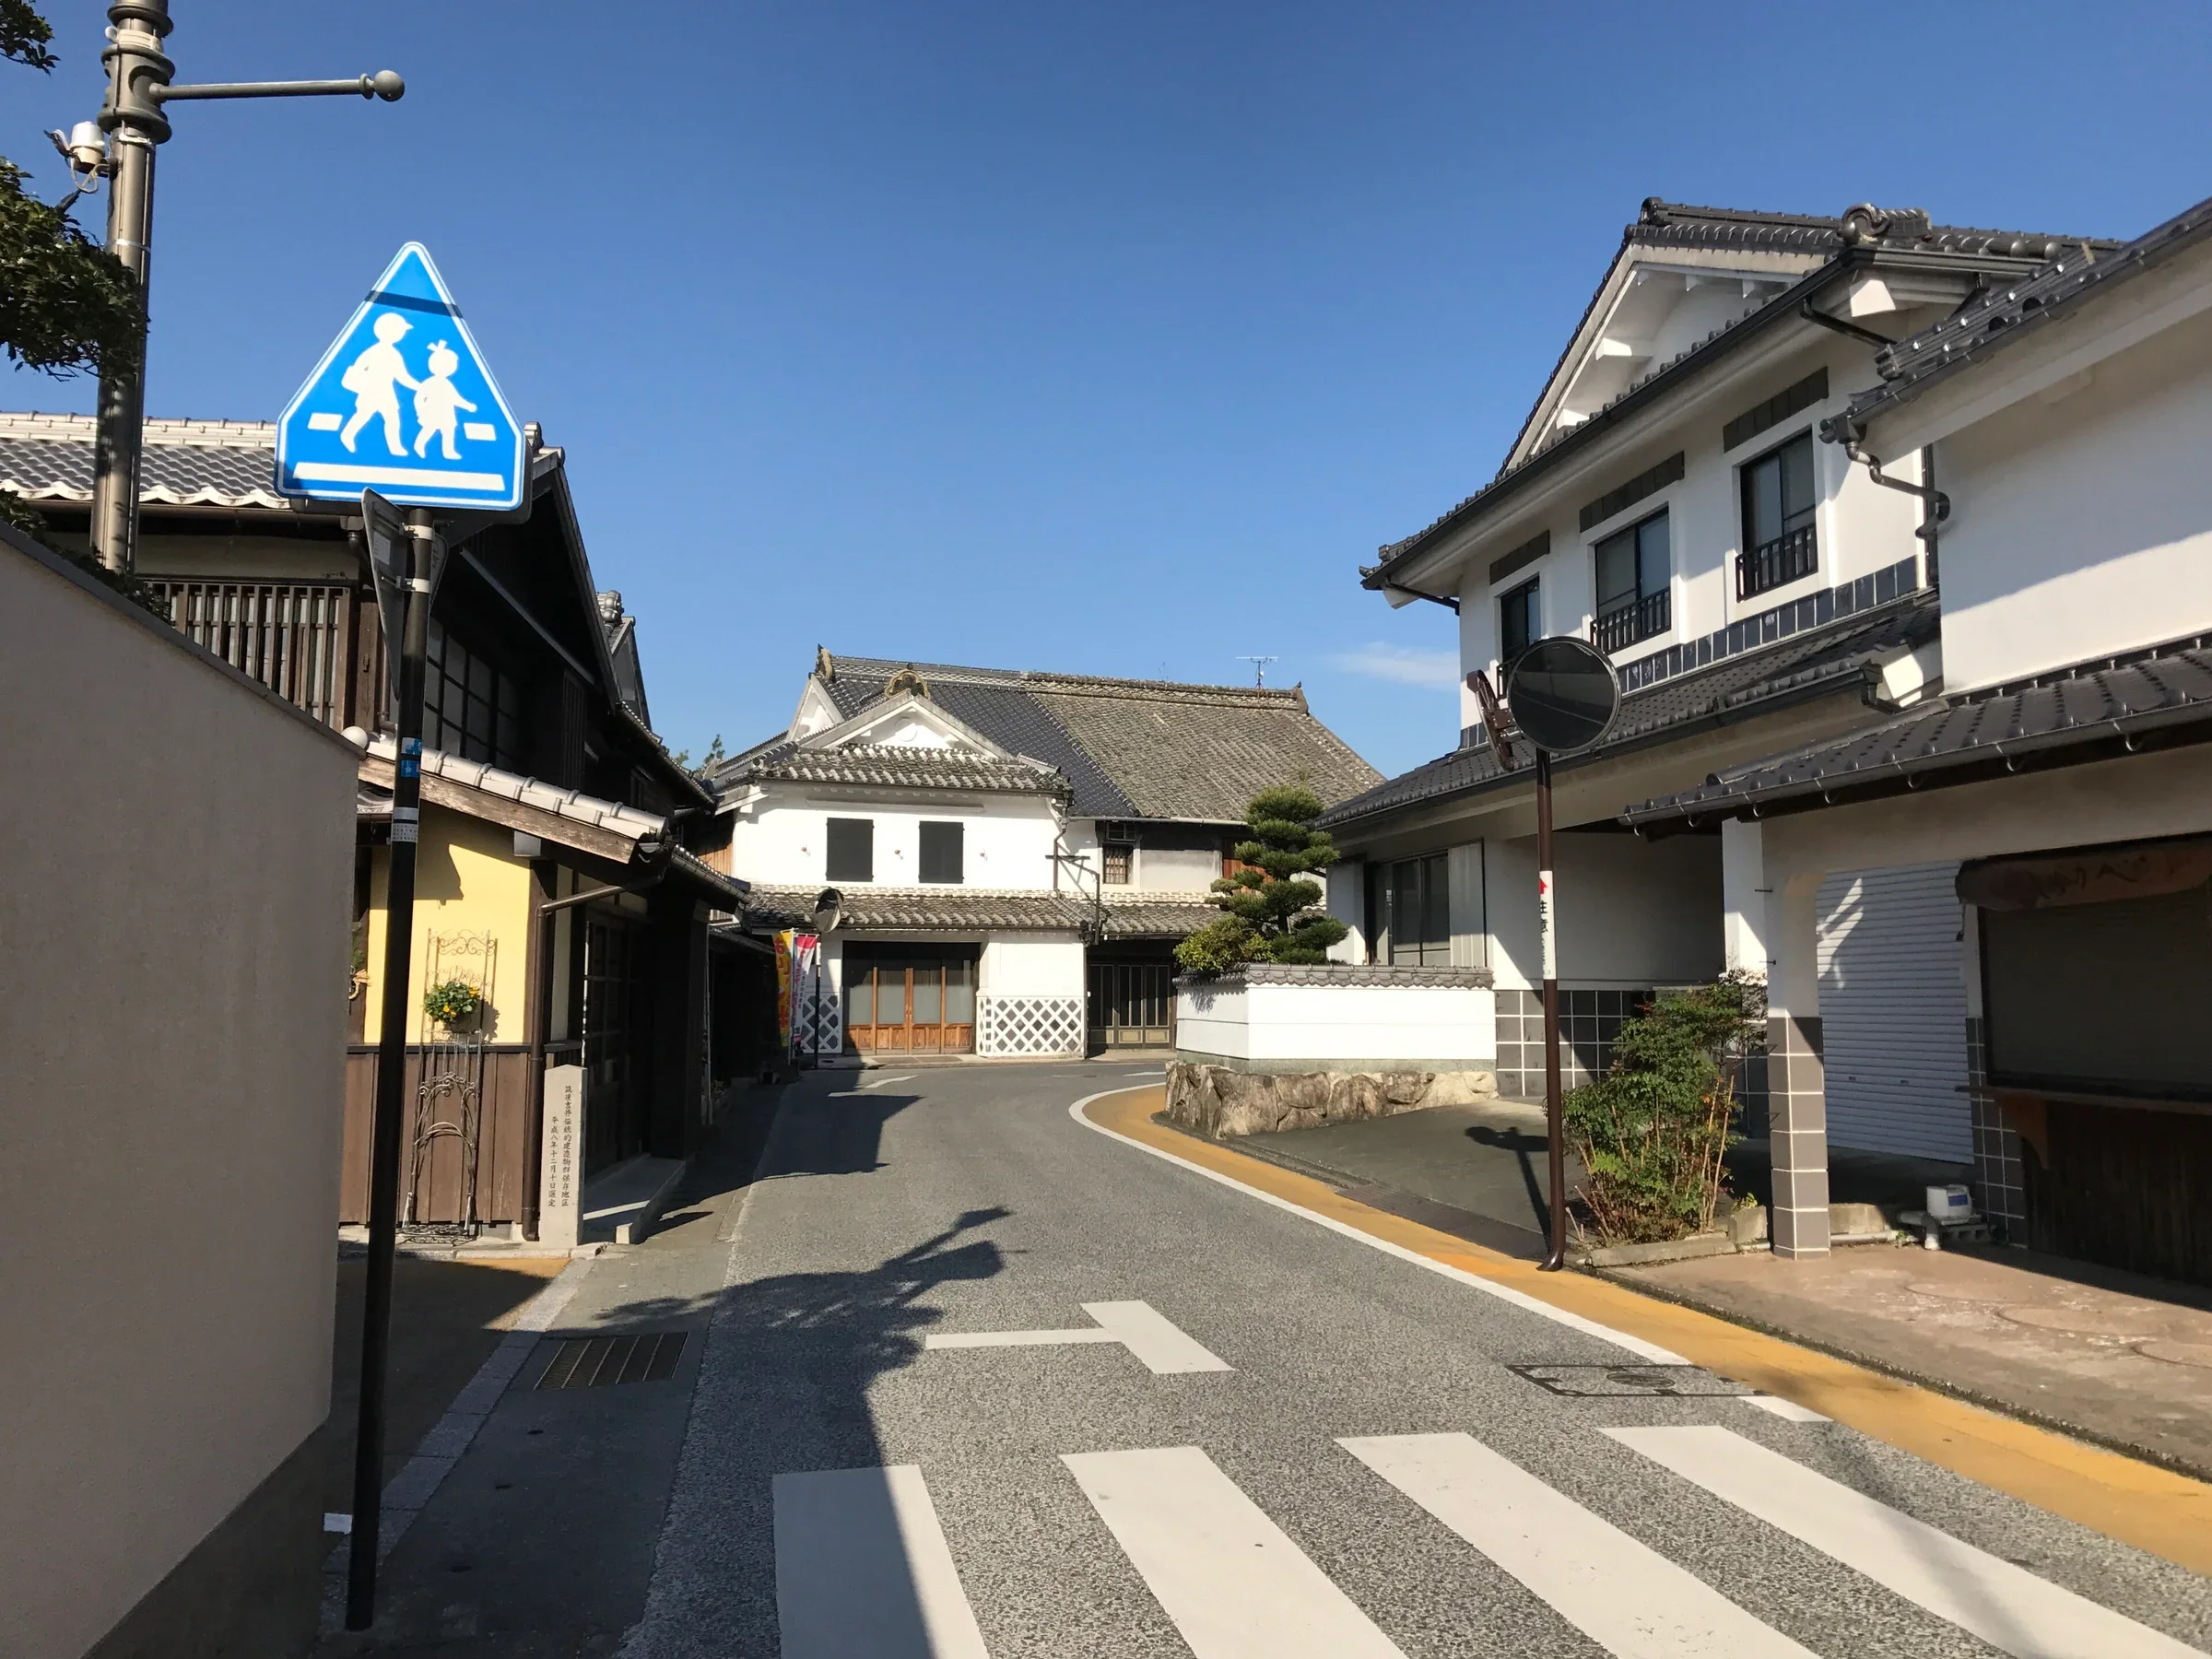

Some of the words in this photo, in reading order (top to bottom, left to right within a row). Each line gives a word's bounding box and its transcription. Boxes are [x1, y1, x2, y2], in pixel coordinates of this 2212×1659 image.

[548, 1115, 559, 1207] 平成八年十二月十日選定
[561, 1085, 572, 1207] 筑後吉井伝統的建造物群保存地区
